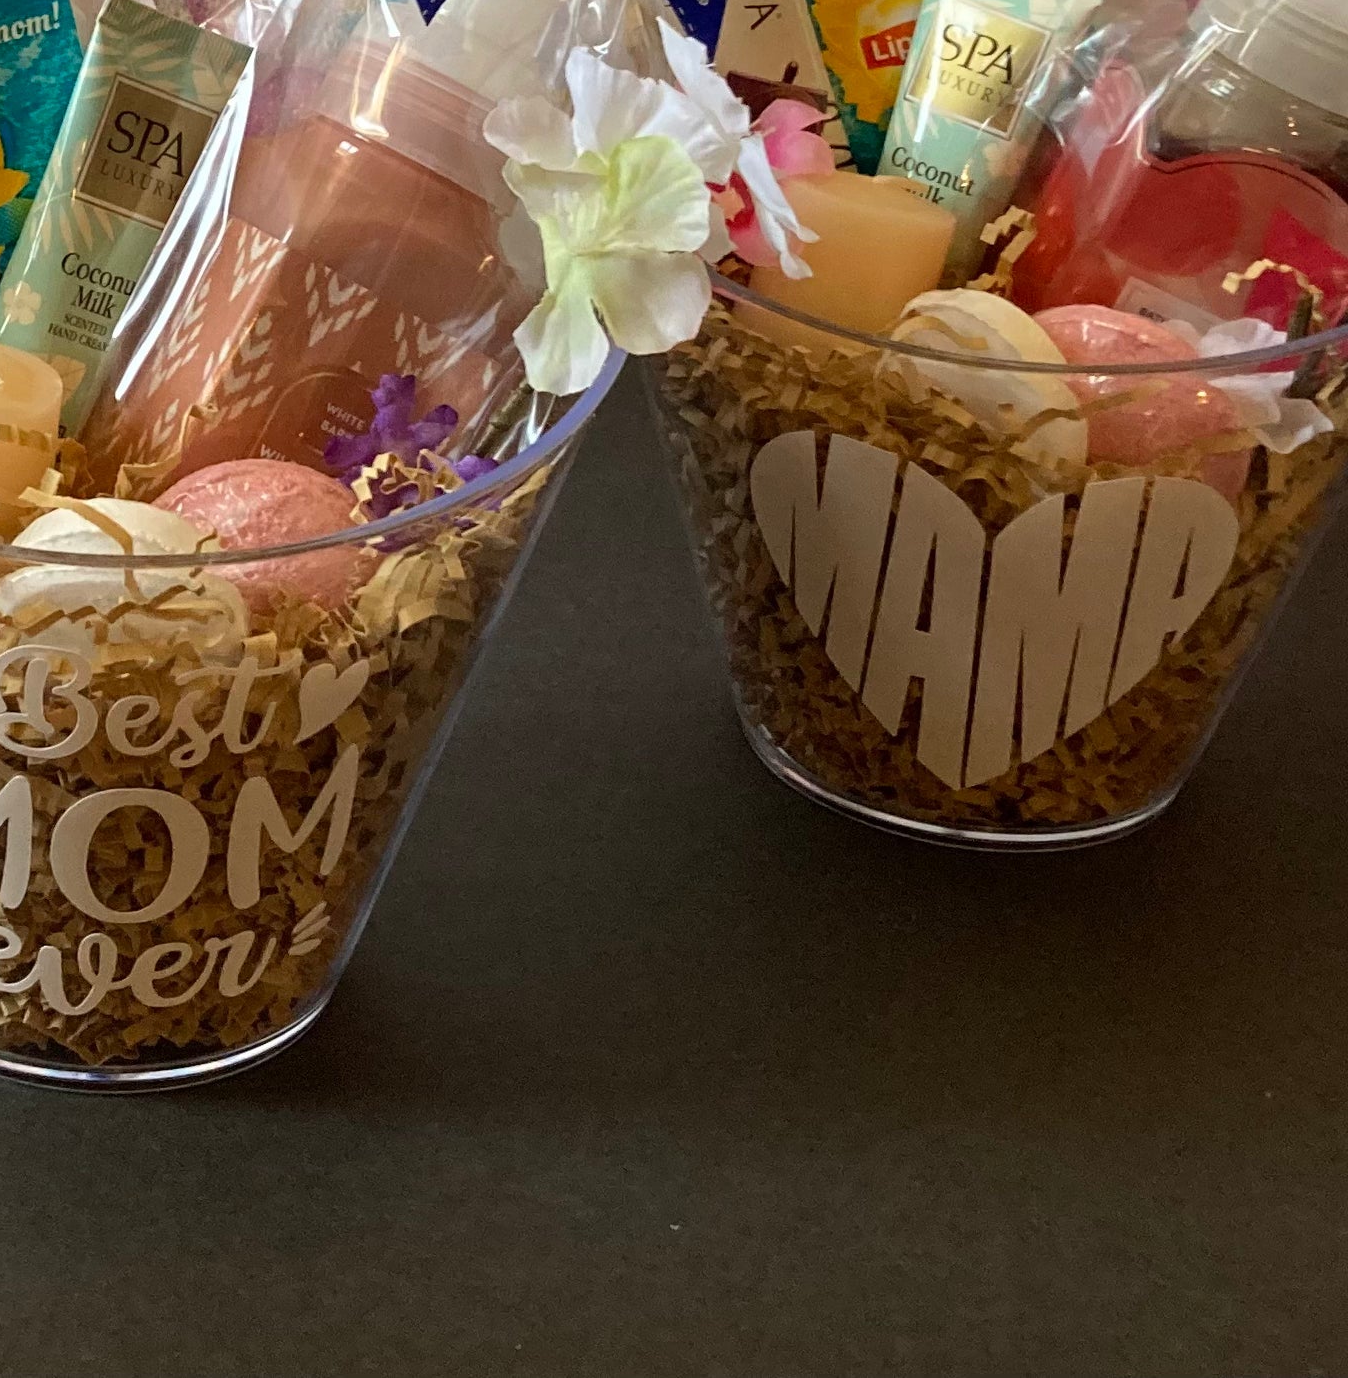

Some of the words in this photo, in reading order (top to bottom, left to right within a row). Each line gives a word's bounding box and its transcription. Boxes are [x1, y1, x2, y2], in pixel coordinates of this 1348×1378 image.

[940, 23, 1014, 85] SPA
[107, 110, 185, 178] SPA
[891, 145, 975, 196] Coconut
[61, 252, 136, 296] Coconu
[71, 284, 116, 319] Milk
[48, 322, 78, 342] HAND
[63, 313, 108, 336] SCENTED
[327, 402, 367, 431] WHITE
